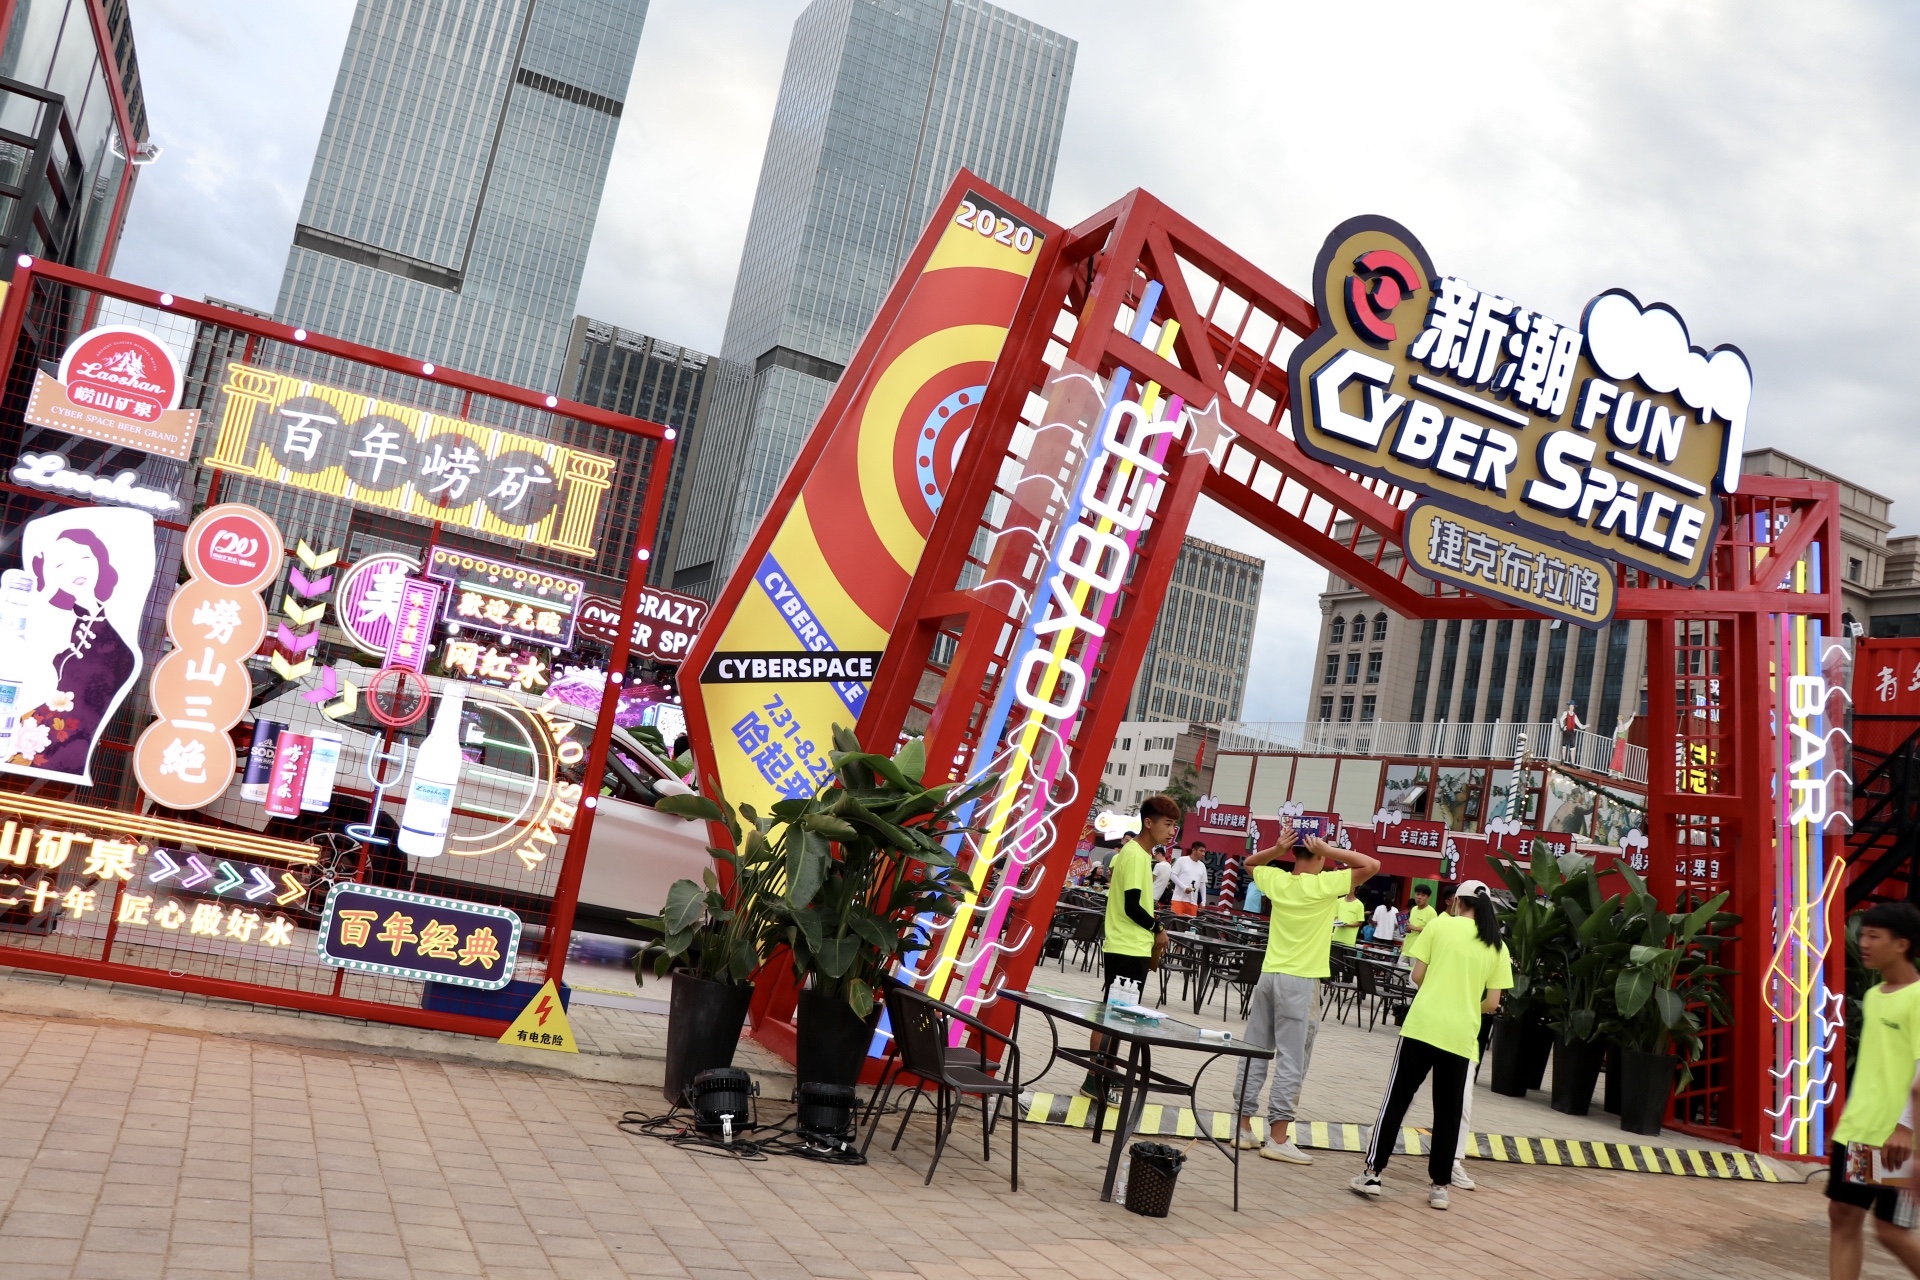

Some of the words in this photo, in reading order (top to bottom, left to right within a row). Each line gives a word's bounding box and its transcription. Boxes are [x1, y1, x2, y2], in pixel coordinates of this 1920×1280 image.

[956, 201, 1034, 254] 2020
[1410, 276, 1584, 416] 新潮
[73, 385, 153, 418] 崂山矿泉
[76, 361, 166, 394] Laoshan
[51, 405, 83, 421] CYBER
[86, 413, 115, 428] SPACE
[118, 422, 142, 436] BEER
[144, 428, 179, 443] GRAND
[1577, 377, 1686, 462] FUN
[280, 408, 553, 511] 百年崂矿
[1311, 348, 1519, 490] CYBER
[1526, 429, 1706, 560] SPACE
[1015, 400, 1176, 720] CYBER
[1428, 516, 1599, 613] 捷克布拉格
[718, 657, 873, 679] CYBERSPACE
[251, 746, 276, 759] SOD
[1787, 675, 1826, 825] BAR
[1210, 812, 1247, 827] 炼丹炉烧烤
[1400, 829, 1439, 847] 辛哥凉菜
[116, 893, 295, 947] 匠心做好水
[339, 909, 500, 969] 百年经典
[517, 1030, 564, 1046] 有电危险
